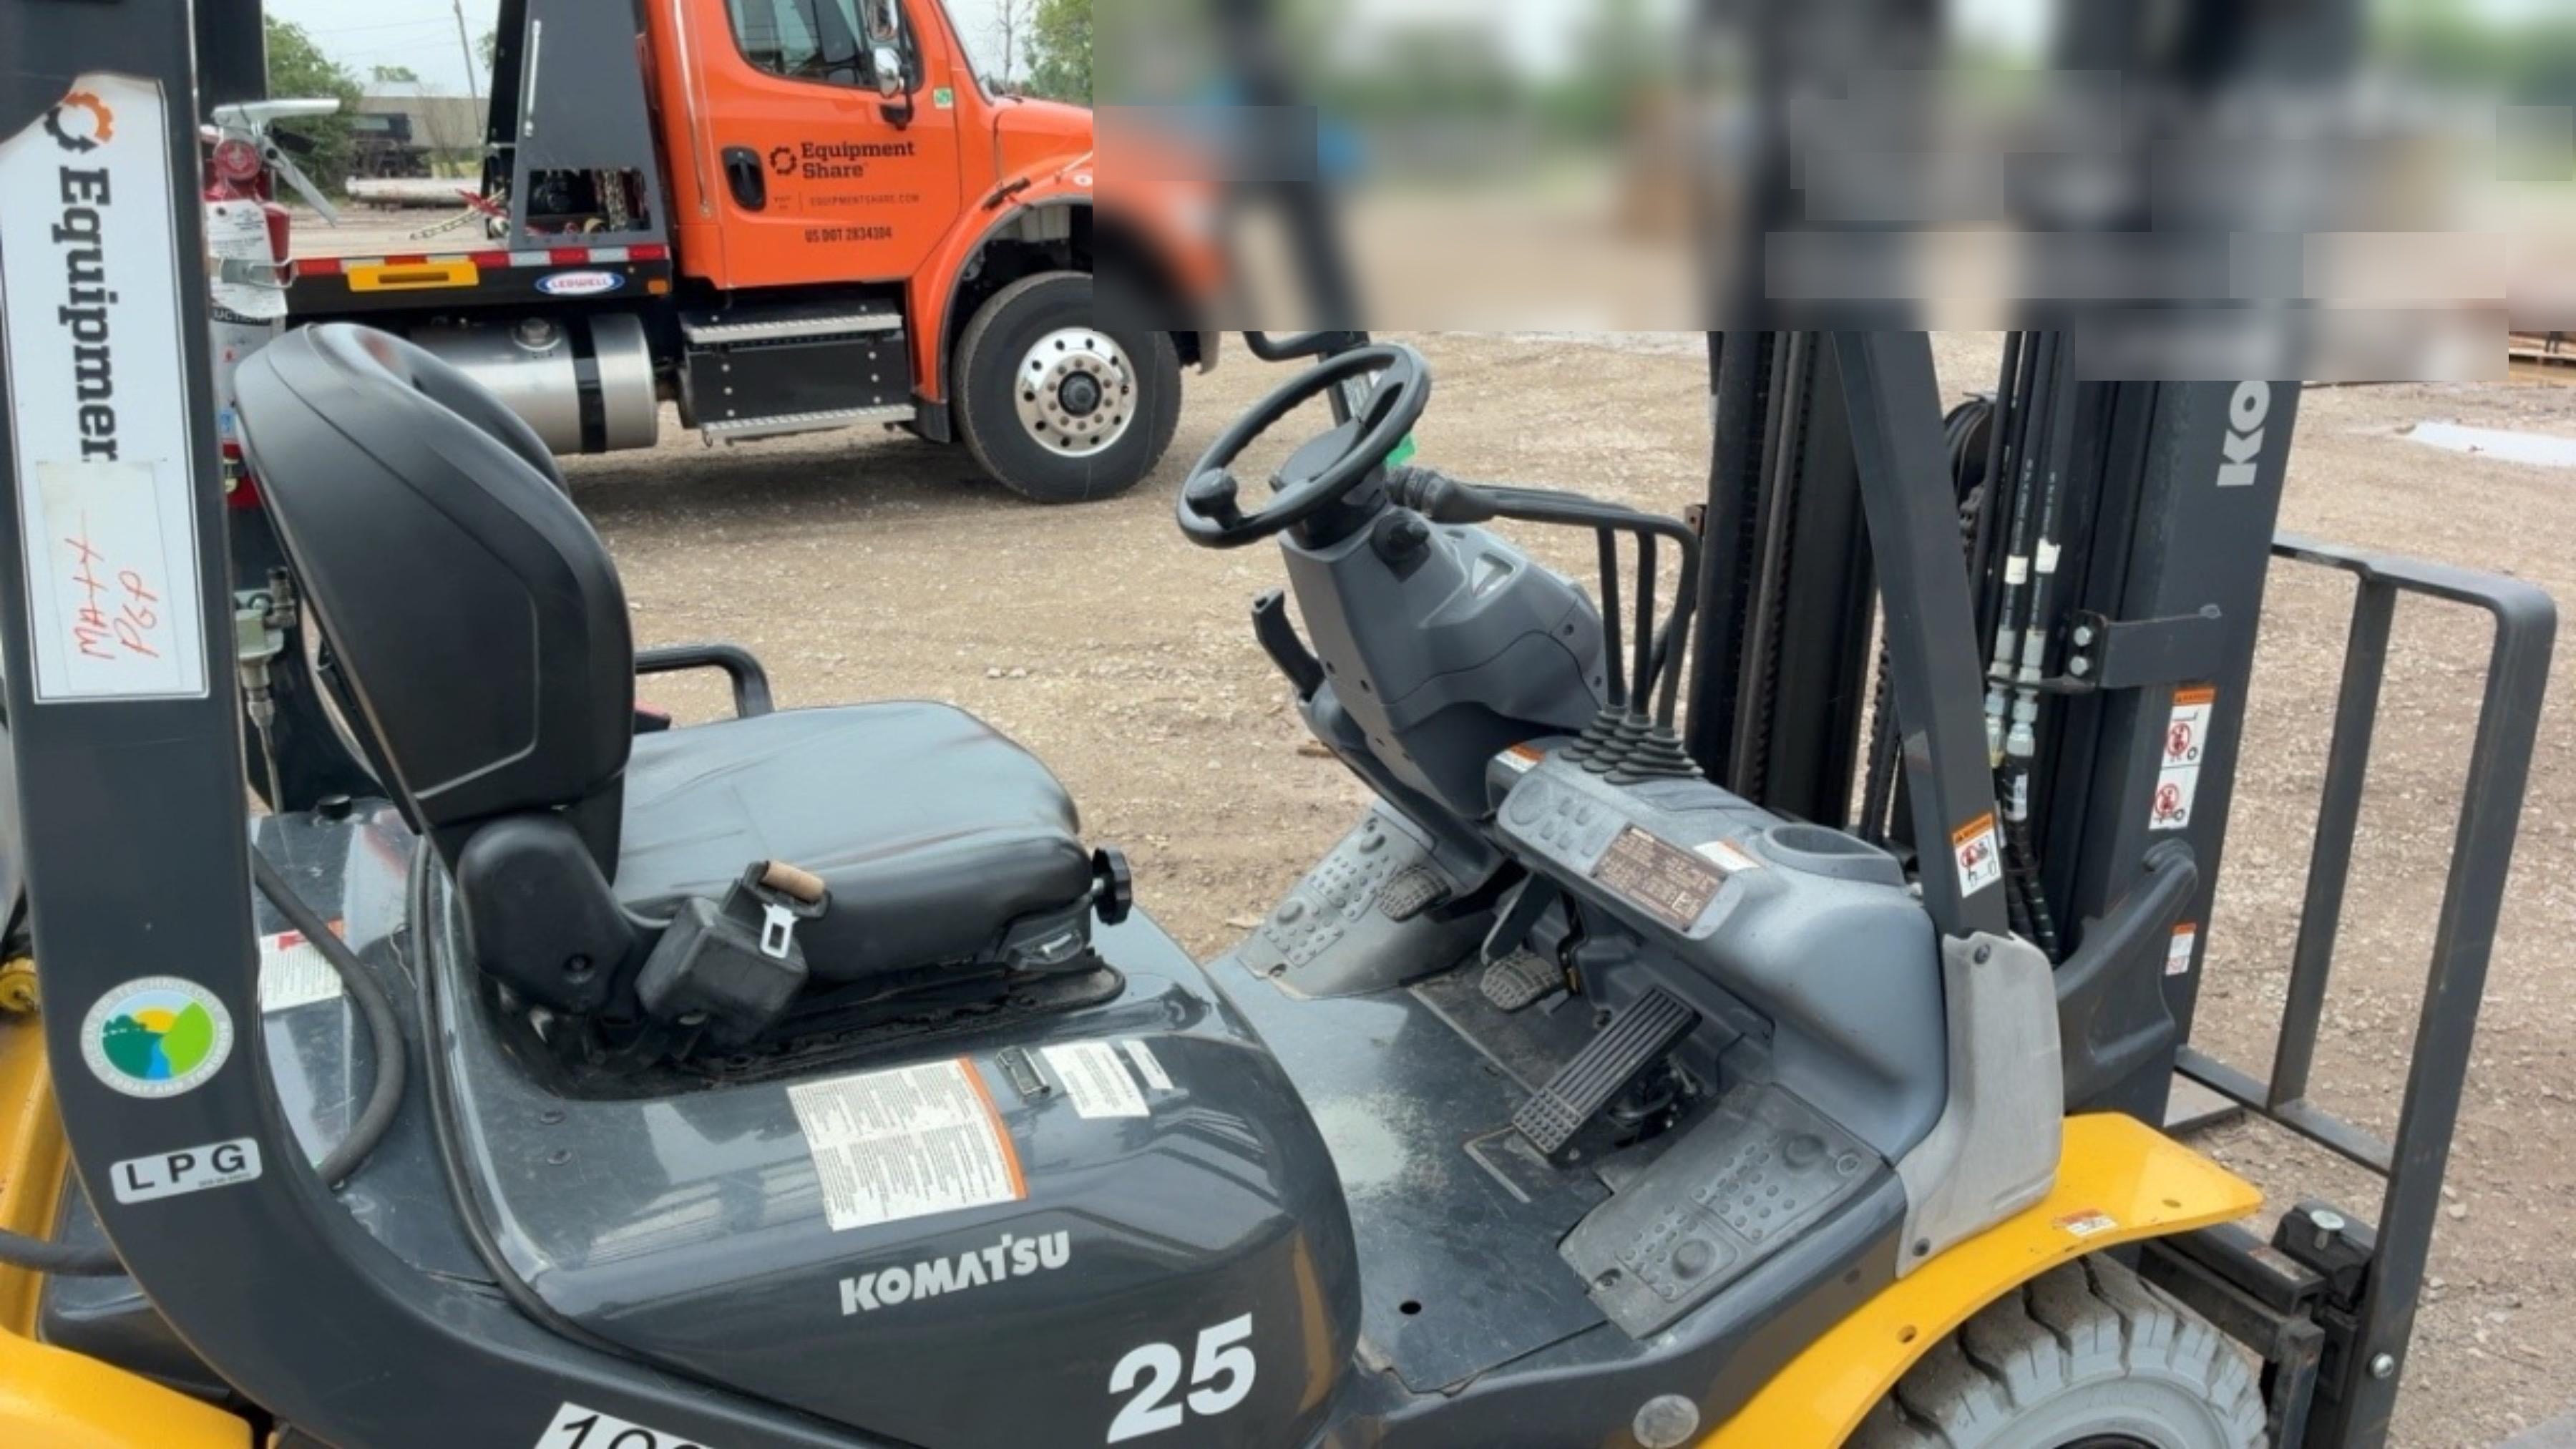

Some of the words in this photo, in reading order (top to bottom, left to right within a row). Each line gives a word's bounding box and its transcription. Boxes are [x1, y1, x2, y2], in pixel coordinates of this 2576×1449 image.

[801, 142, 914, 161] Equipment
[802, 162, 864, 179] Share
[804, 228, 819, 243] US
[821, 228, 842, 242] DOT
[839, 1230, 1070, 1317] KOMATSU
[1107, 1312, 1257, 1443] 25
